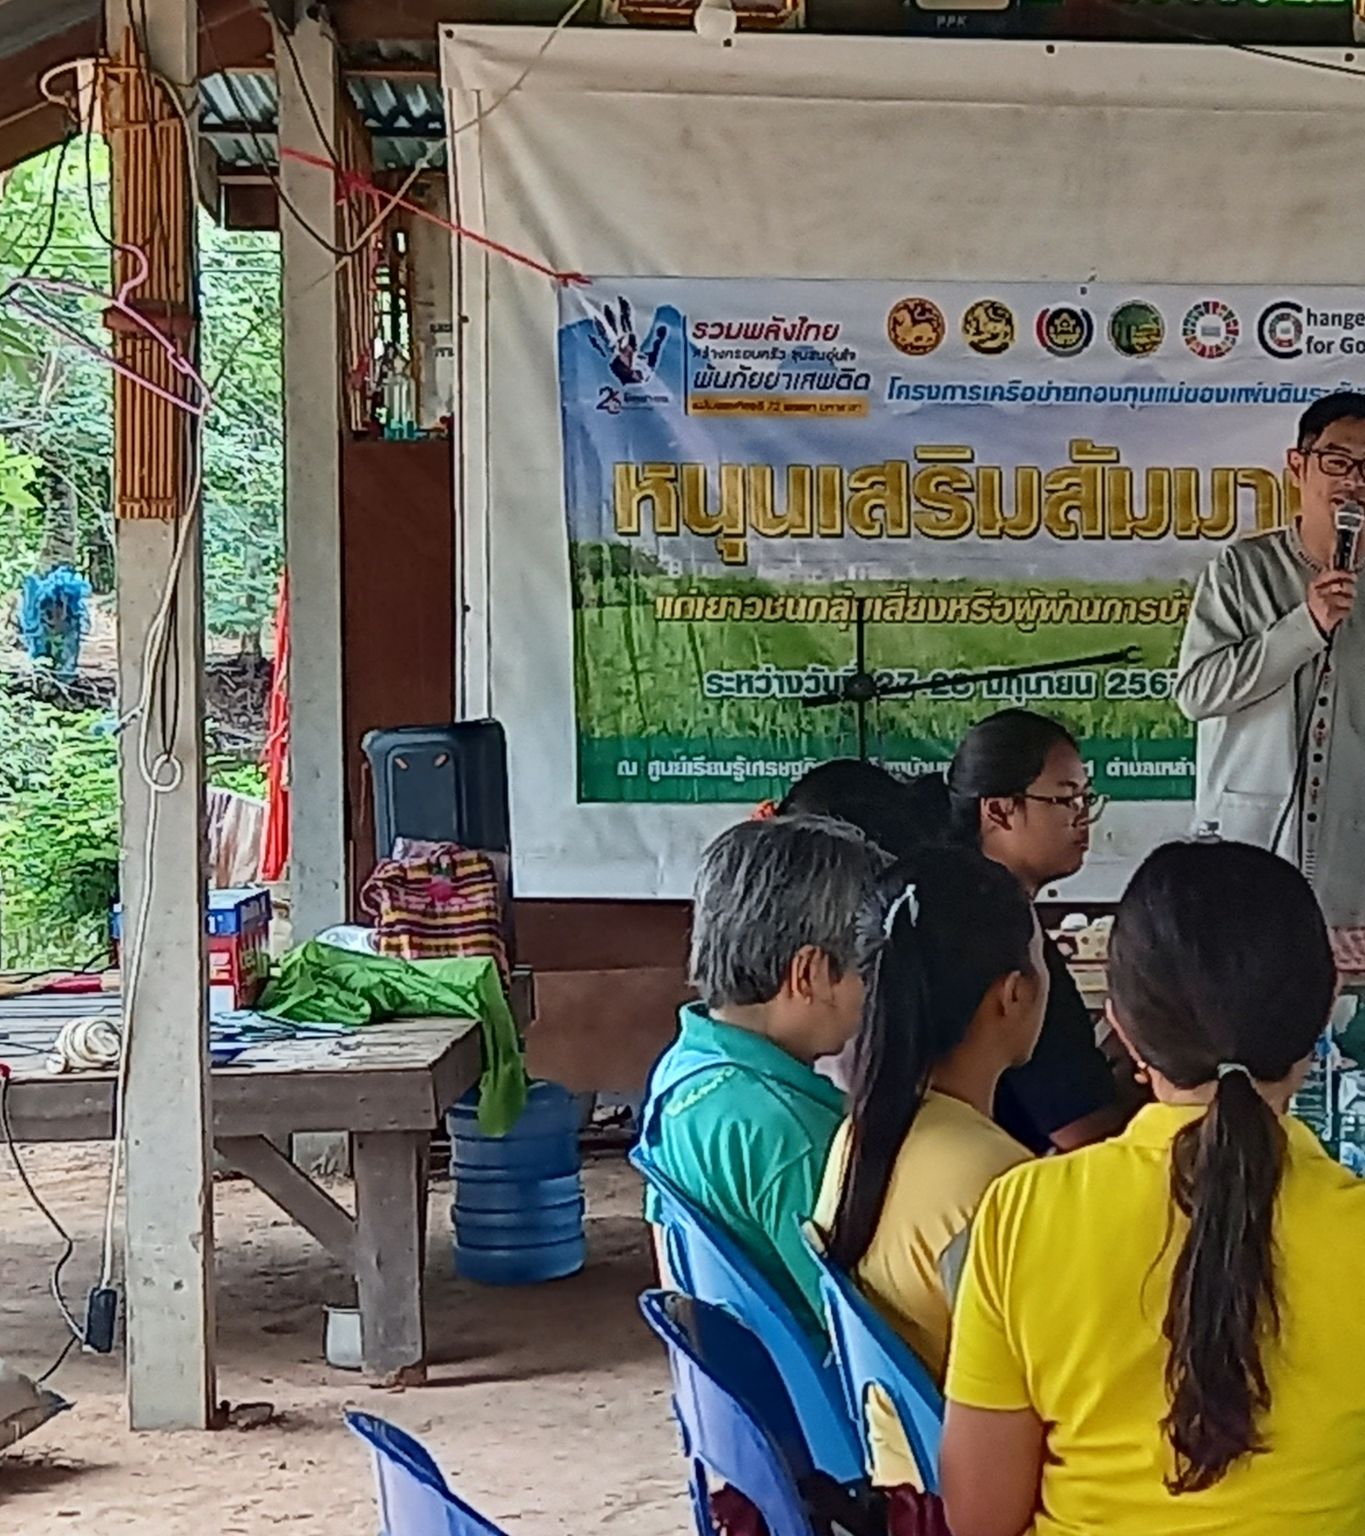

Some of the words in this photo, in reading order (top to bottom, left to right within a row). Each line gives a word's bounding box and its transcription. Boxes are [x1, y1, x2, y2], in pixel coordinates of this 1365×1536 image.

[693, 316, 840, 341] รวมพลังไทย
[1306, 336, 1335, 354] for
[693, 365, 871, 390] พ้นภัยยาเสพติด
[617, 760, 638, 775] ณ
